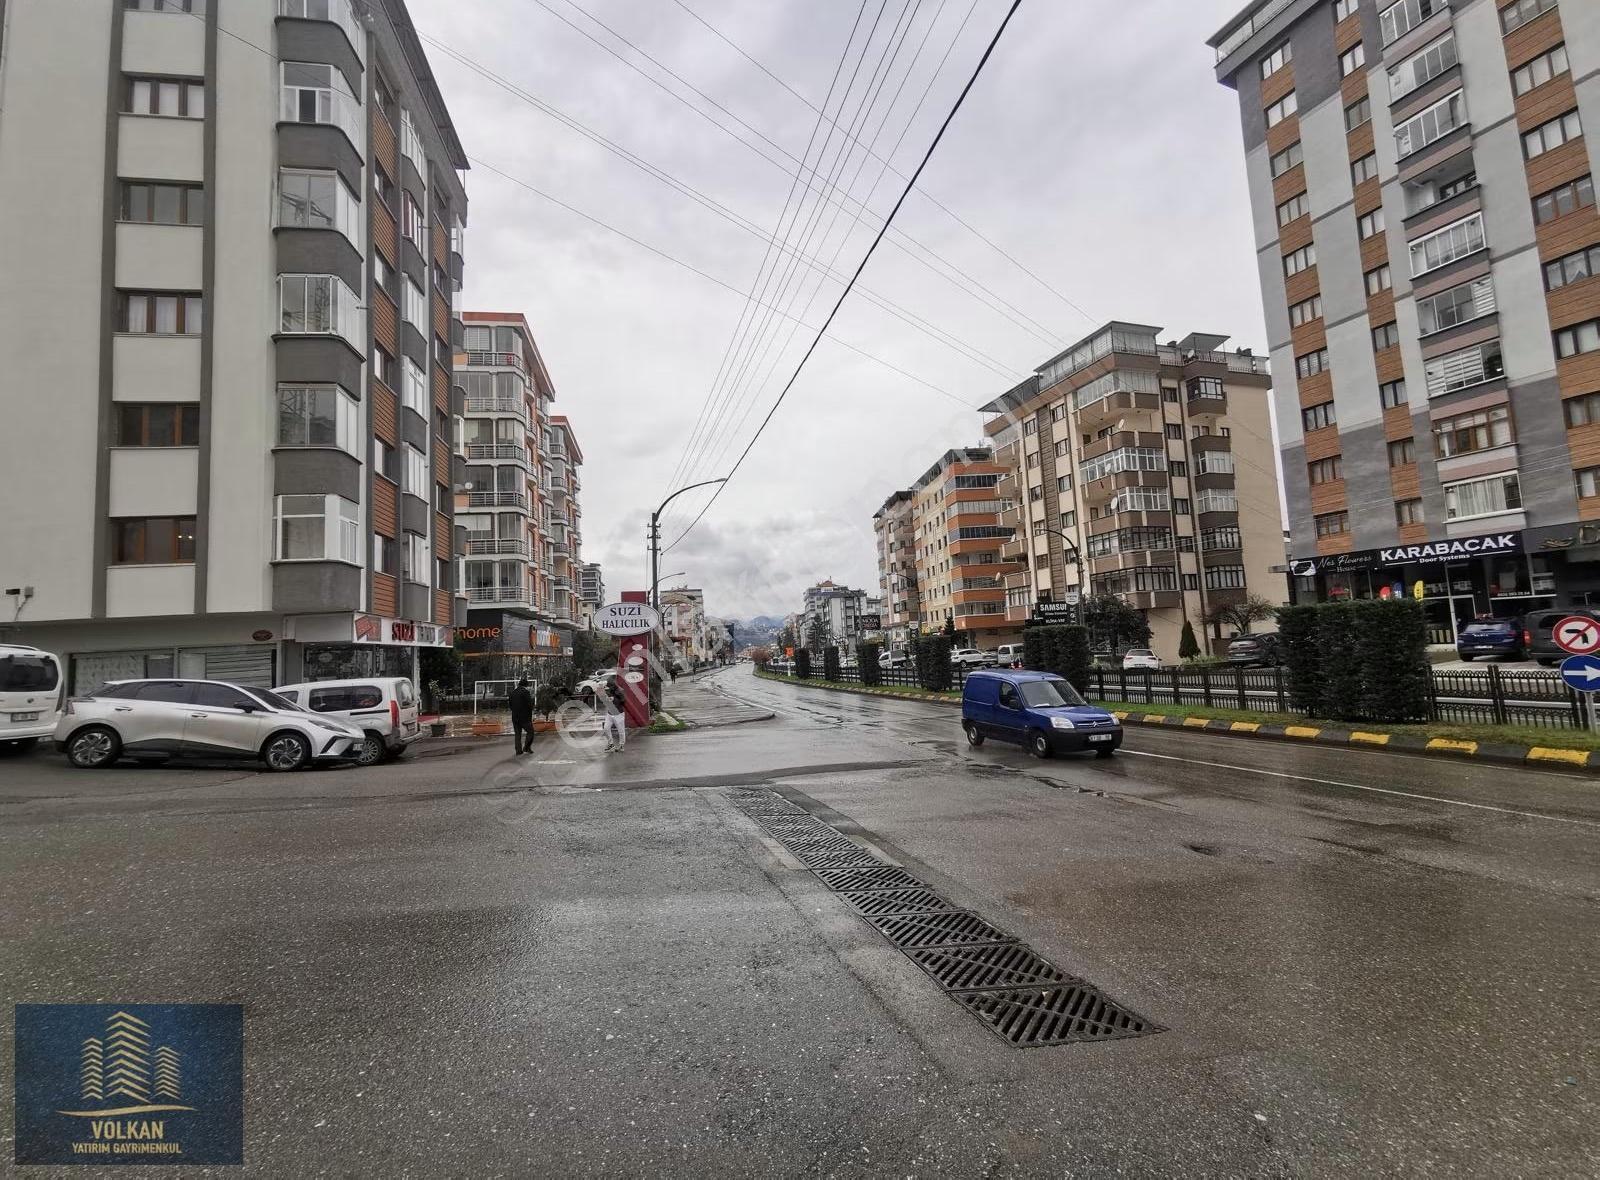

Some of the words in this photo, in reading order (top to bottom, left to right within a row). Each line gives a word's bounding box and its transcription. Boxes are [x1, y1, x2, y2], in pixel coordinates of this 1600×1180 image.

[1380, 534, 1517, 562] KARABACAK
[1439, 554, 1471, 563] Systems
[610, 605, 642, 617] SUZİ
[602, 619, 651, 629] HALICILIK
[457, 626, 502, 639] home
